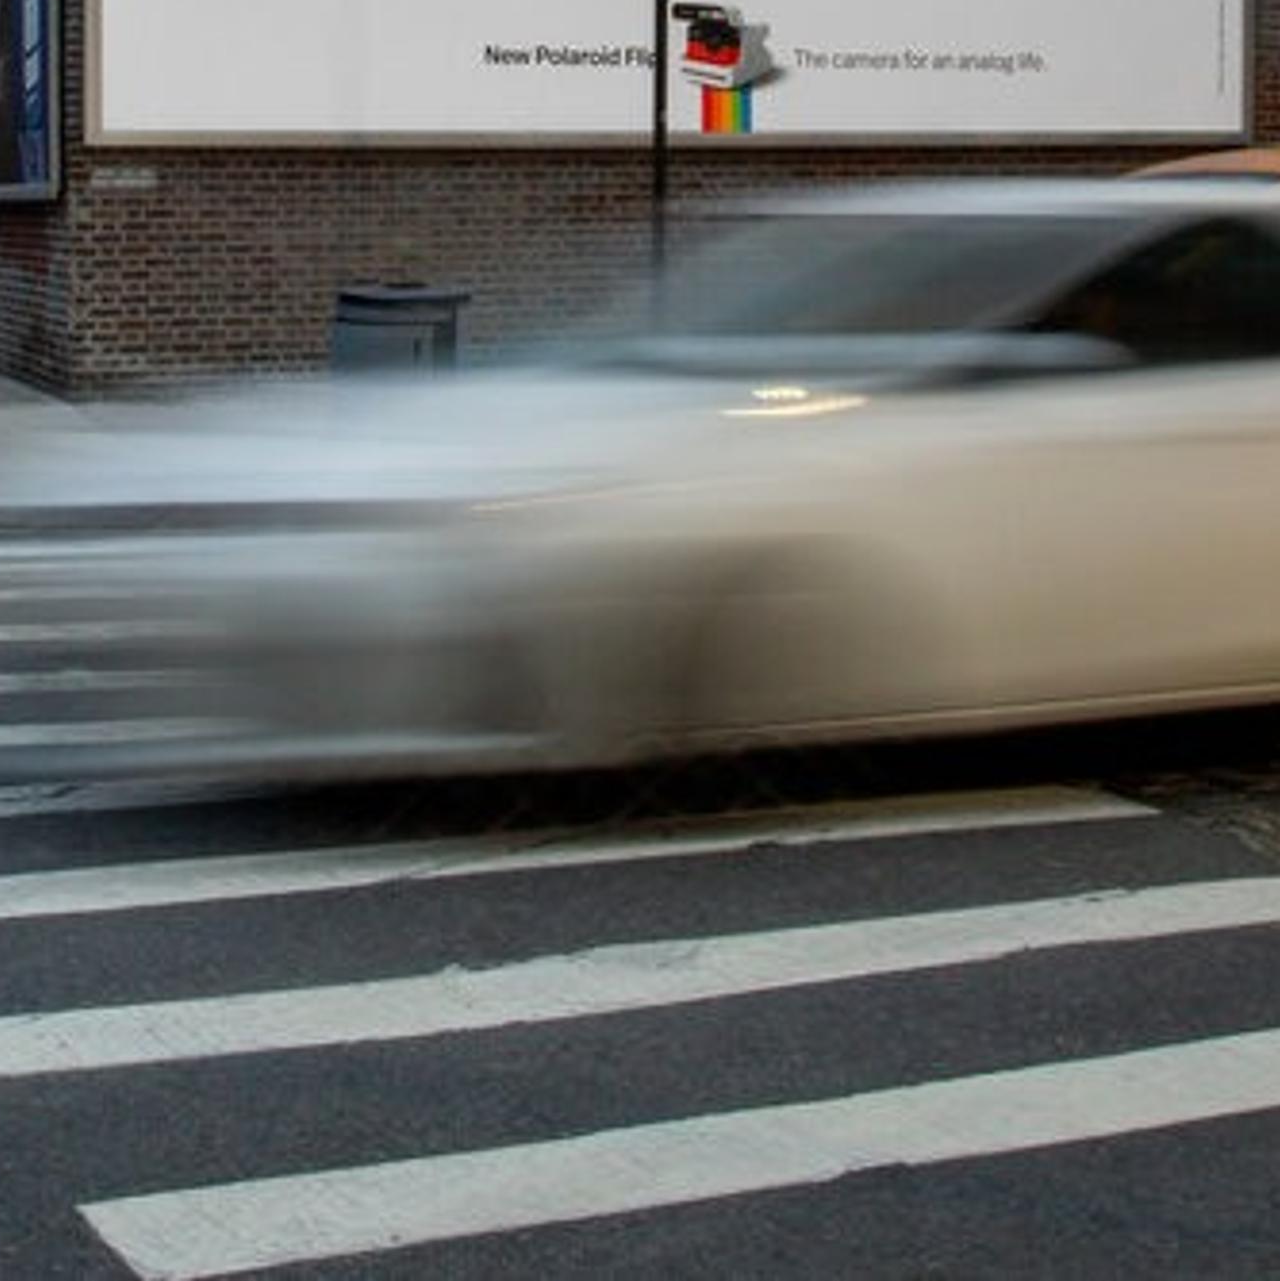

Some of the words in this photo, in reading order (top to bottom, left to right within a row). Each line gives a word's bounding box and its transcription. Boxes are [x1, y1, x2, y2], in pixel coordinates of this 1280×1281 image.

[484, 44, 530, 65] New
[536, 44, 621, 66] Polaroid
[794, 48, 828, 69] The
[832, 52, 899, 70] camera
[904, 49, 928, 70] for
[932, 54, 953, 70] an
[959, 51, 1013, 75] analog
